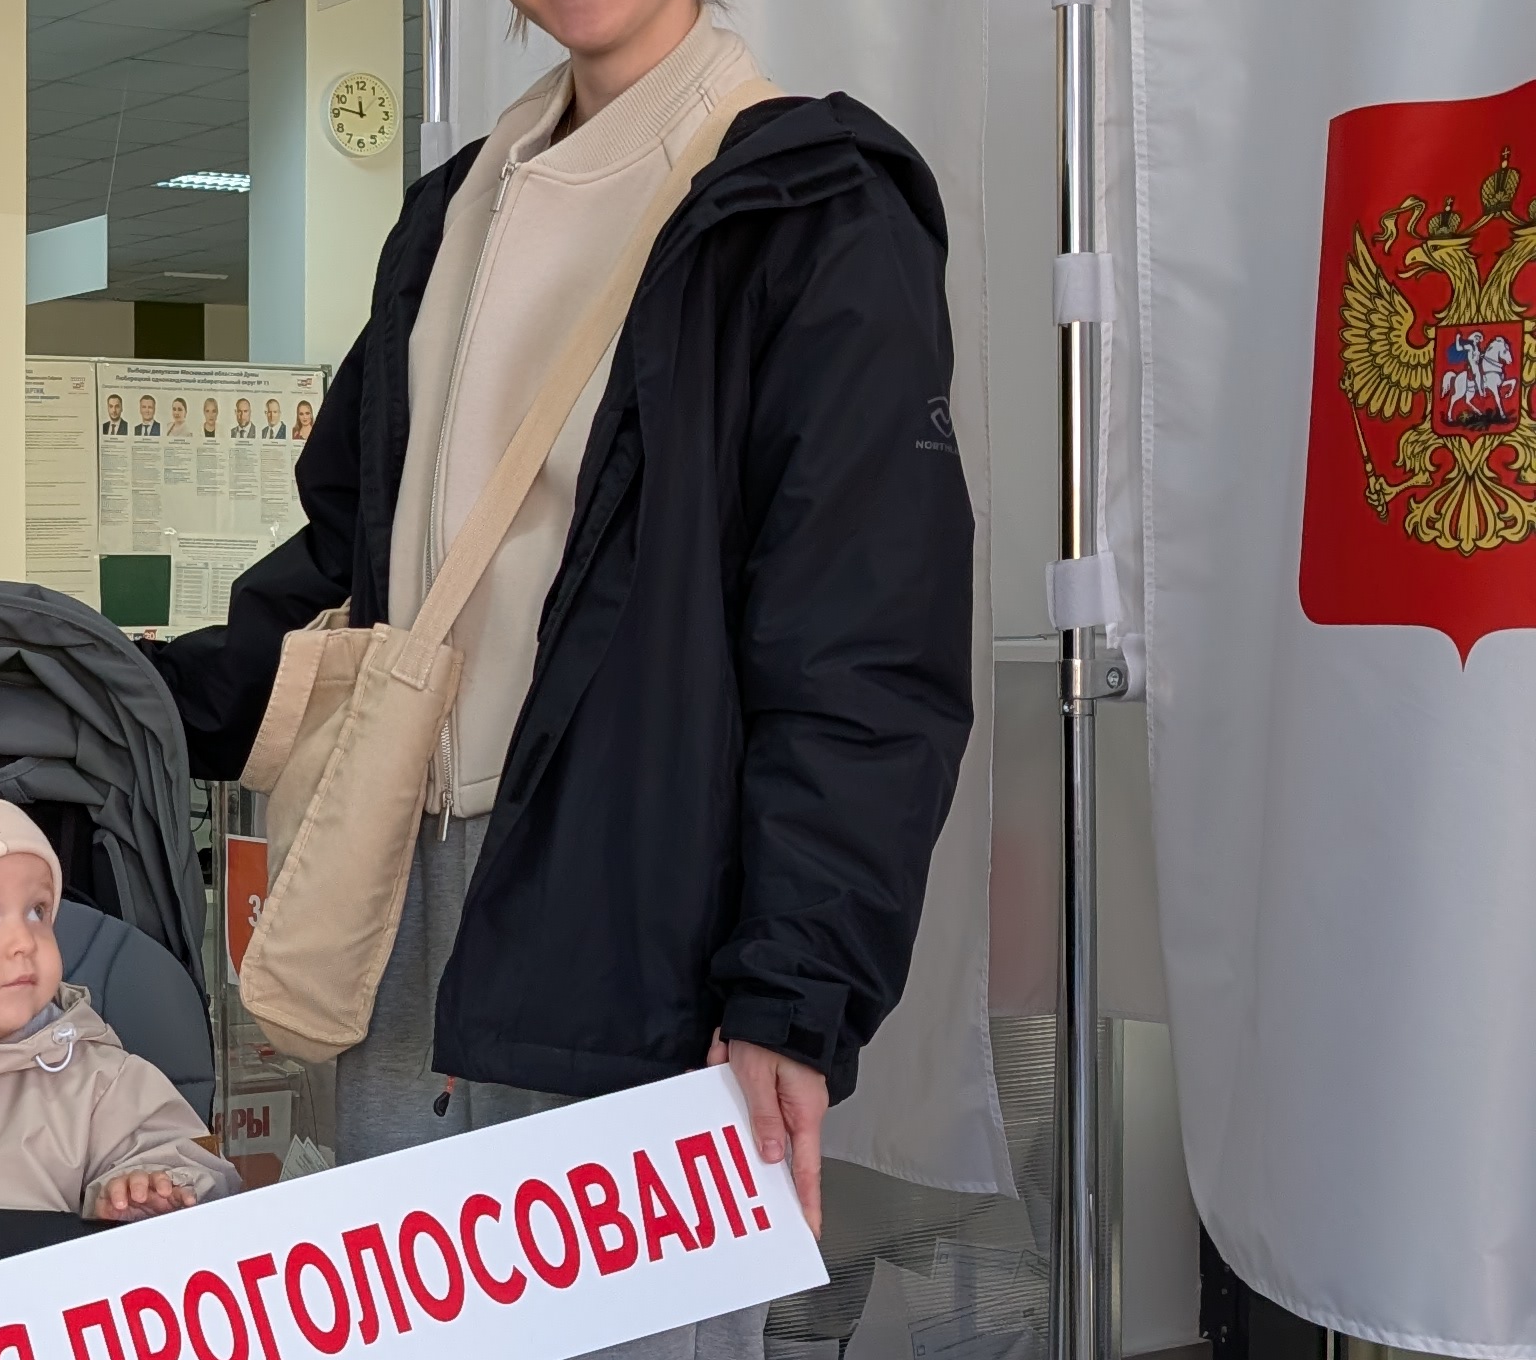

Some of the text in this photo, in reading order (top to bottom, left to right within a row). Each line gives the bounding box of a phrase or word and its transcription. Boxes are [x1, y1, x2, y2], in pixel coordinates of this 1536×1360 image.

[345, 84, 354, 95] 11
[356, 81, 367, 91] 12
[371, 86, 376, 96] 1
[336, 94, 348, 105] 10
[378, 97, 386, 108] 2
[332, 108, 341, 119] 9
[382, 111, 390, 122] 3
[337, 123, 345, 133] 8
[378, 125, 386, 135] 4
[346, 133, 354, 144] 7
[370, 135, 378, 145] 5
[357, 139, 366, 149] 6
